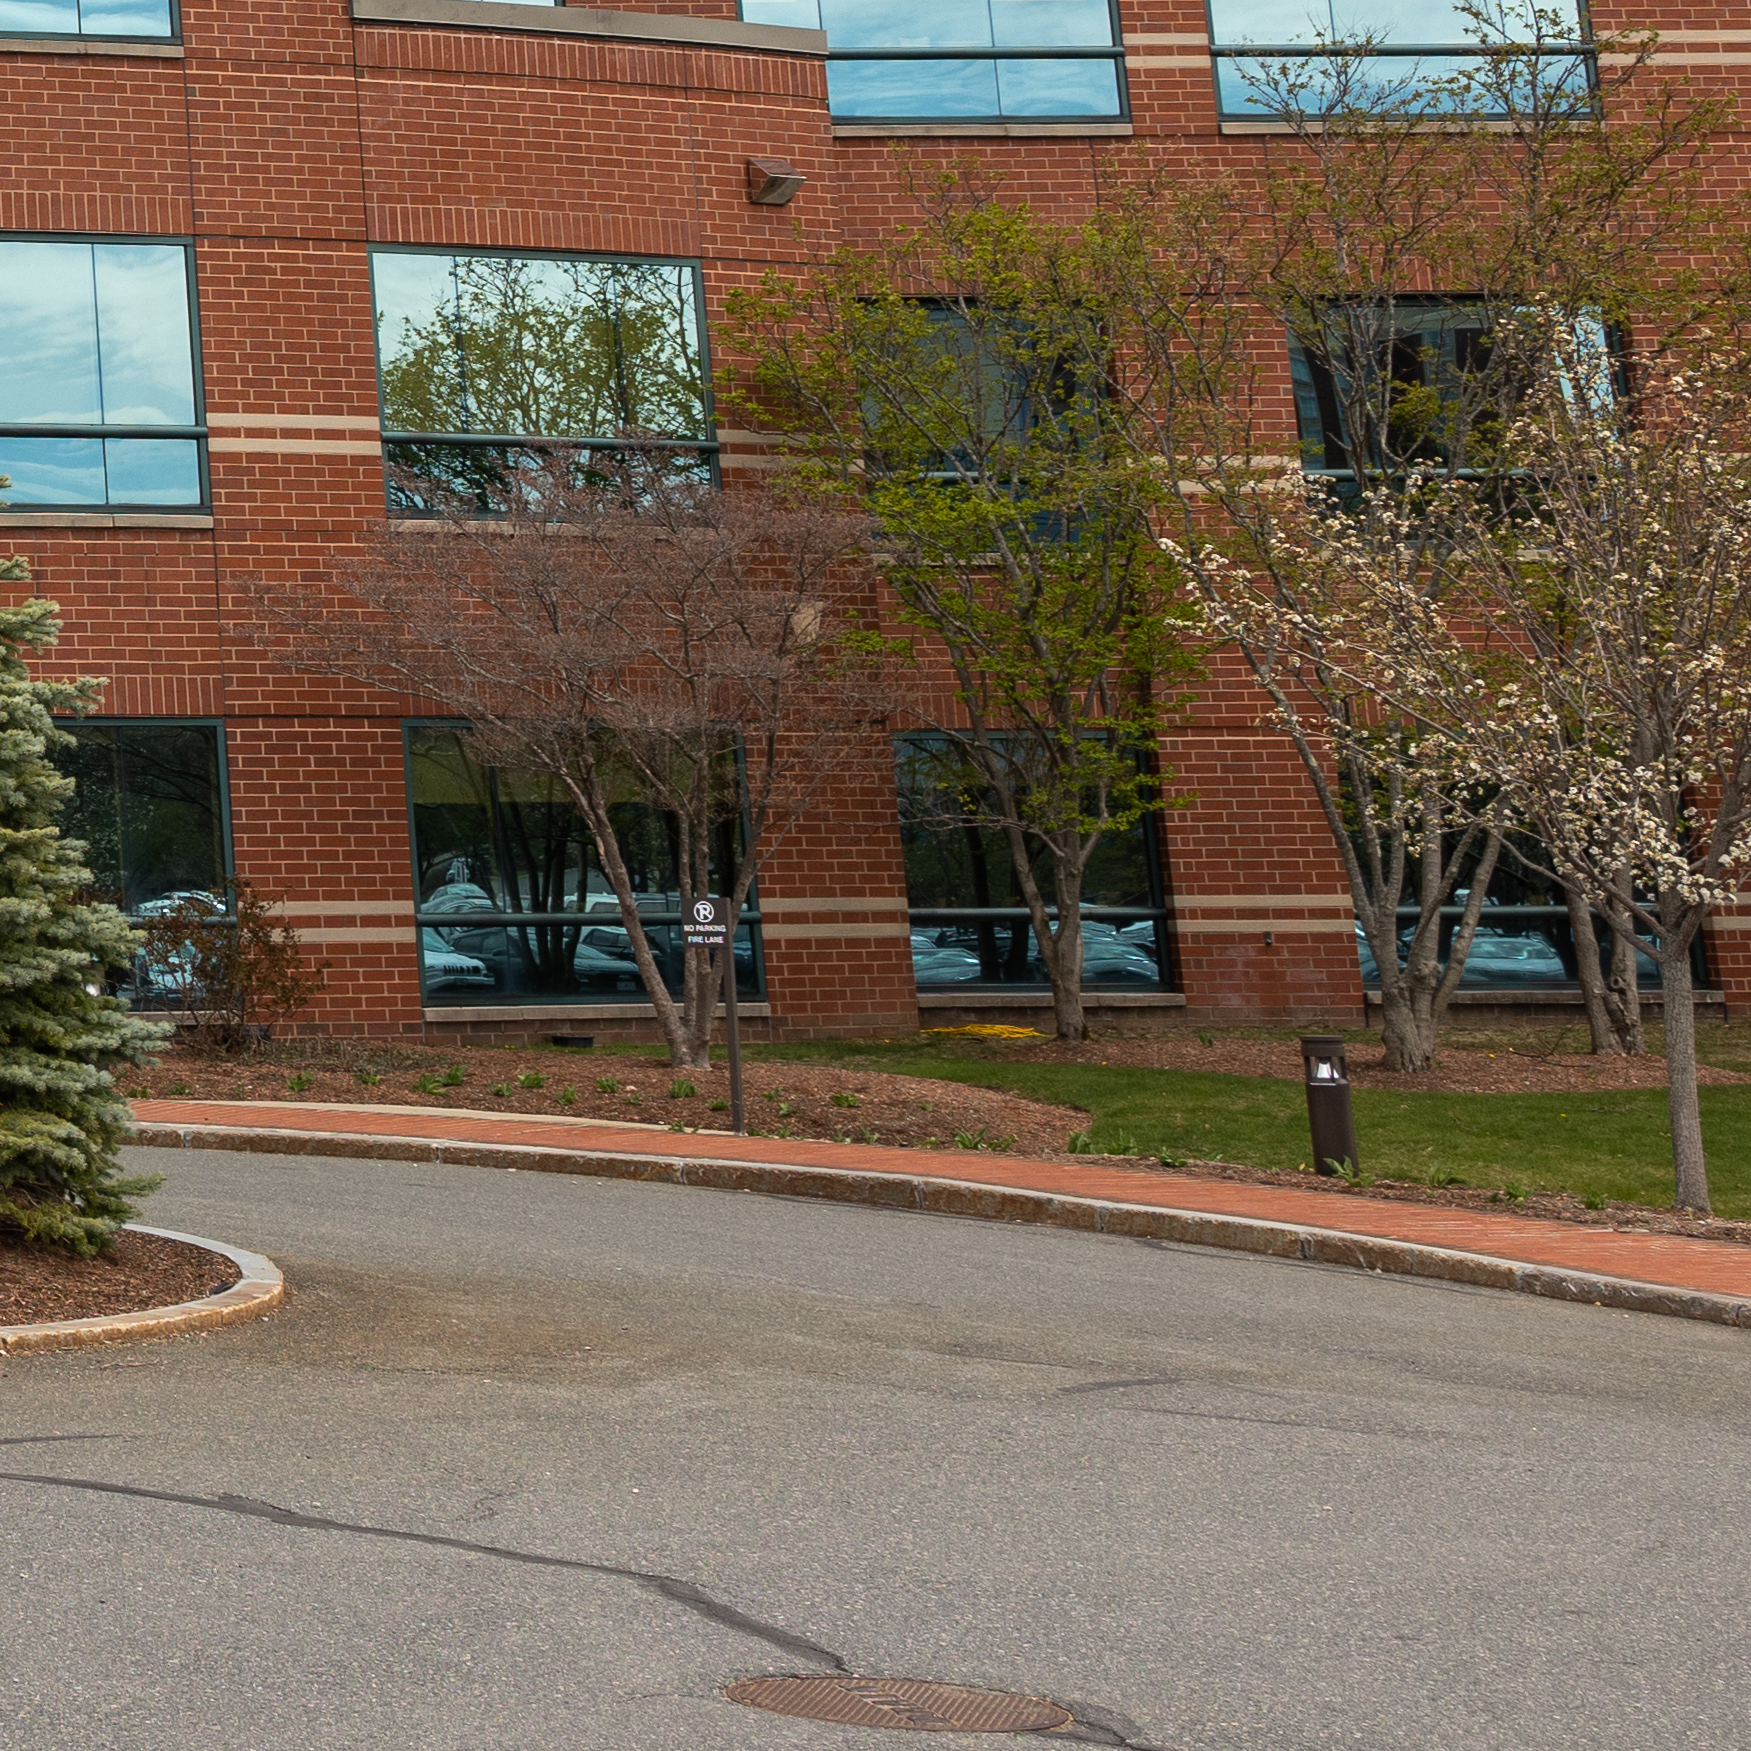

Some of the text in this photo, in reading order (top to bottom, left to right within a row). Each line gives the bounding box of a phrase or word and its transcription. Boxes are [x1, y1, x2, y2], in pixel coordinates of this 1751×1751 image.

[684, 924, 727, 932] NO PARKING
[688, 936, 724, 944] FIRE LANE
